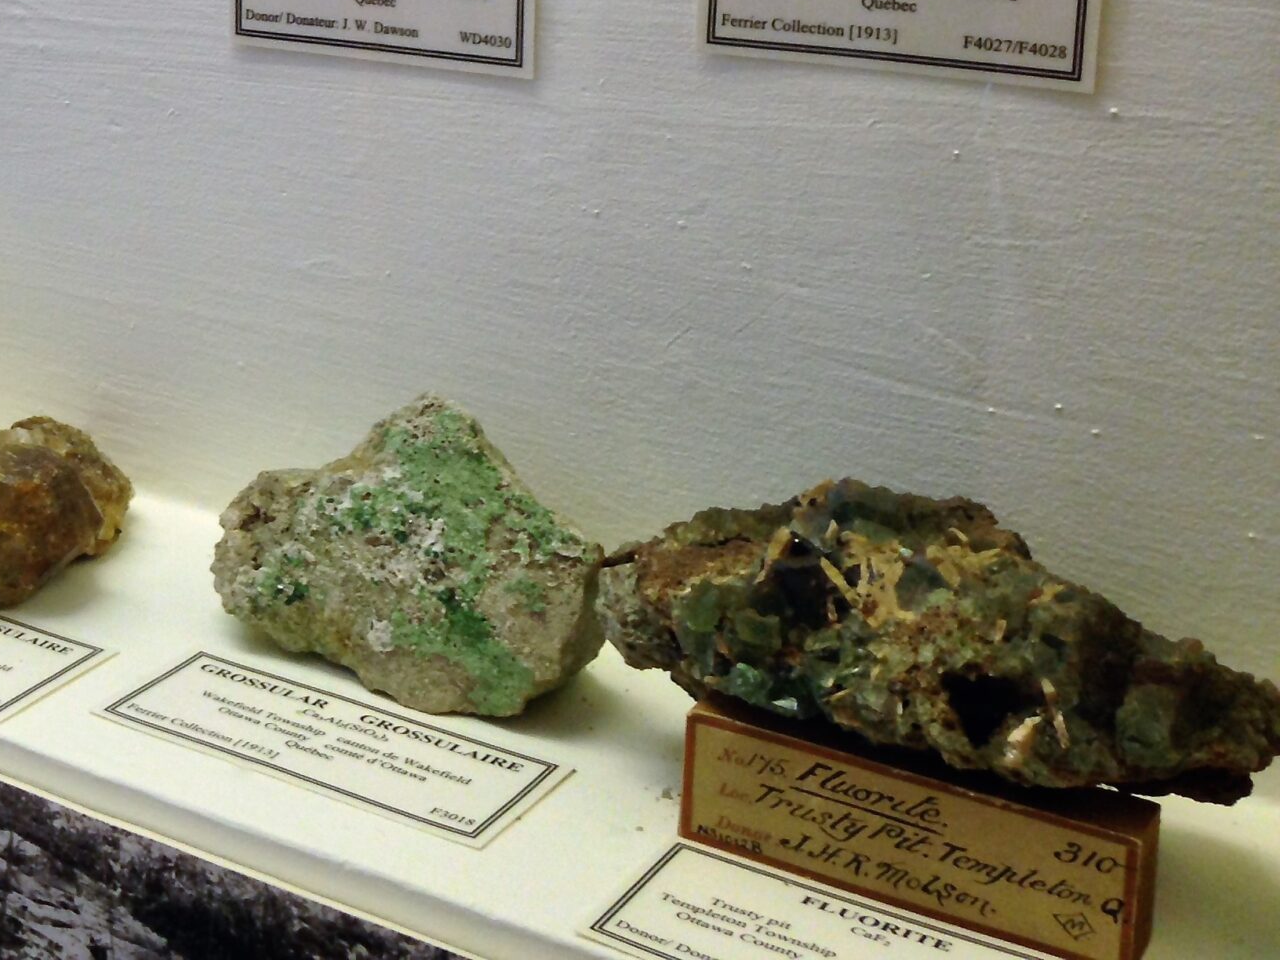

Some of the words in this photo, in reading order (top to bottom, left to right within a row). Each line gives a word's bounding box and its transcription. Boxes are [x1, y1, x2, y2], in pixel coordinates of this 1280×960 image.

[374, 21, 419, 38] Dawson
[460, 31, 512, 49] WD4030
[721, 14, 768, 30] Ferrier
[772, 18, 844, 37] Collection
[849, 25, 899, 44] [1913]
[963, 35, 1067, 59] F4027/F4028
[200, 662, 329, 709] GROSSULAR
[359, 713, 524, 773] GROSSULAIRE
[126, 702, 169, 723] Ferrier
[170, 717, 233, 743] Collection
[429, 806, 476, 827] F3018
[753, 783, 868, 841] Trusty
[937, 841, 1091, 907] Templeton
[1053, 840, 1118, 875] 310
[660, 890, 752, 932] Templeton
[754, 923, 837, 959] Township
[711, 896, 766, 923] Trusty
[769, 913, 791, 930] pit
[800, 895, 952, 953] FLUORITE
